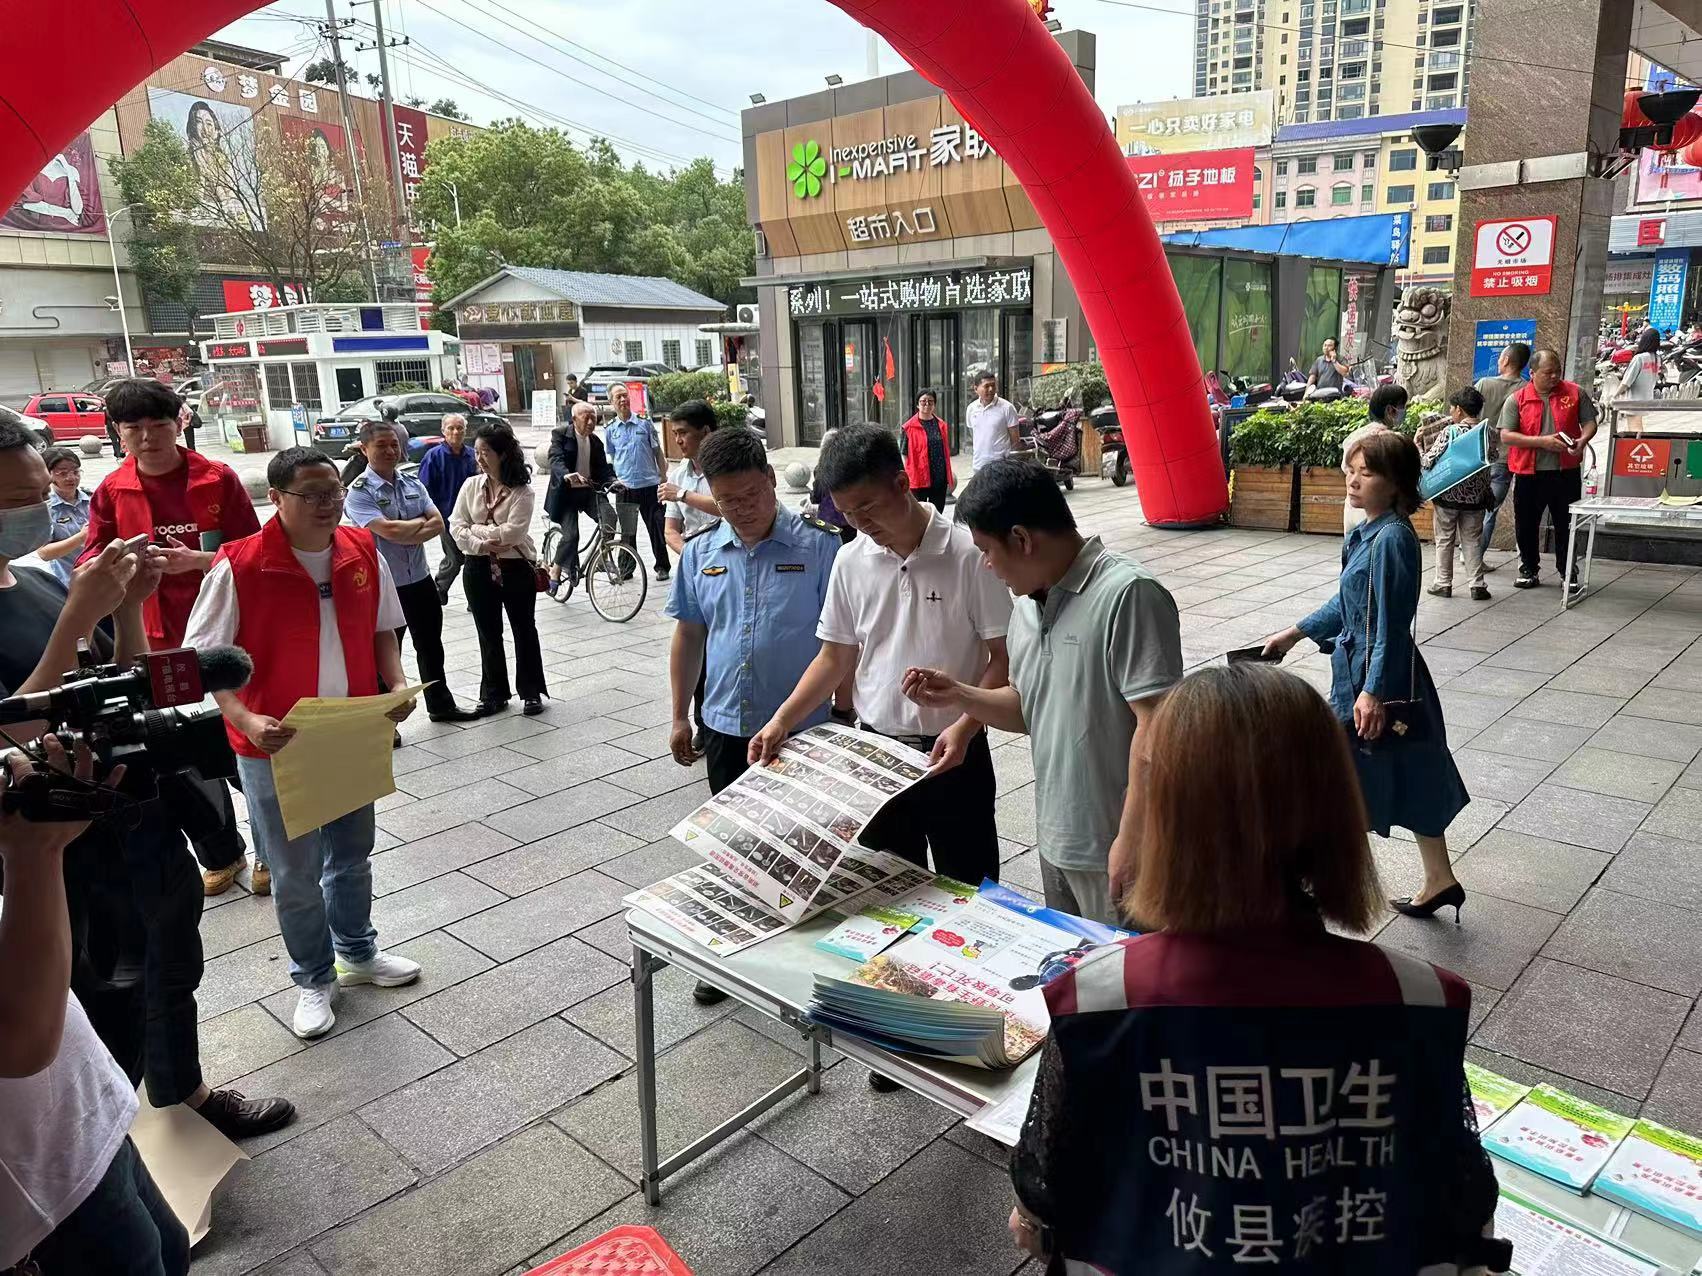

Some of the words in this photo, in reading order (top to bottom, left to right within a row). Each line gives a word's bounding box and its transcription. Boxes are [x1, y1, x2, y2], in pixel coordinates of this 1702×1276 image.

[1129, 110, 1255, 136] 一心只卖好家电
[829, 134, 916, 163] Inexpensive
[1168, 166, 1236, 188] 扬子地板
[846, 207, 936, 242] 超市入口
[1483, 275, 1539, 289] 禁止吸烟
[1655, 264, 1683, 303] 数码照相
[1139, 1058, 1397, 1140] 中国卫生
[1148, 1136, 1262, 1180] CHINA
[1285, 1134, 1394, 1180] HEALTH
[1165, 1186, 1387, 1264] 攸县疾控
